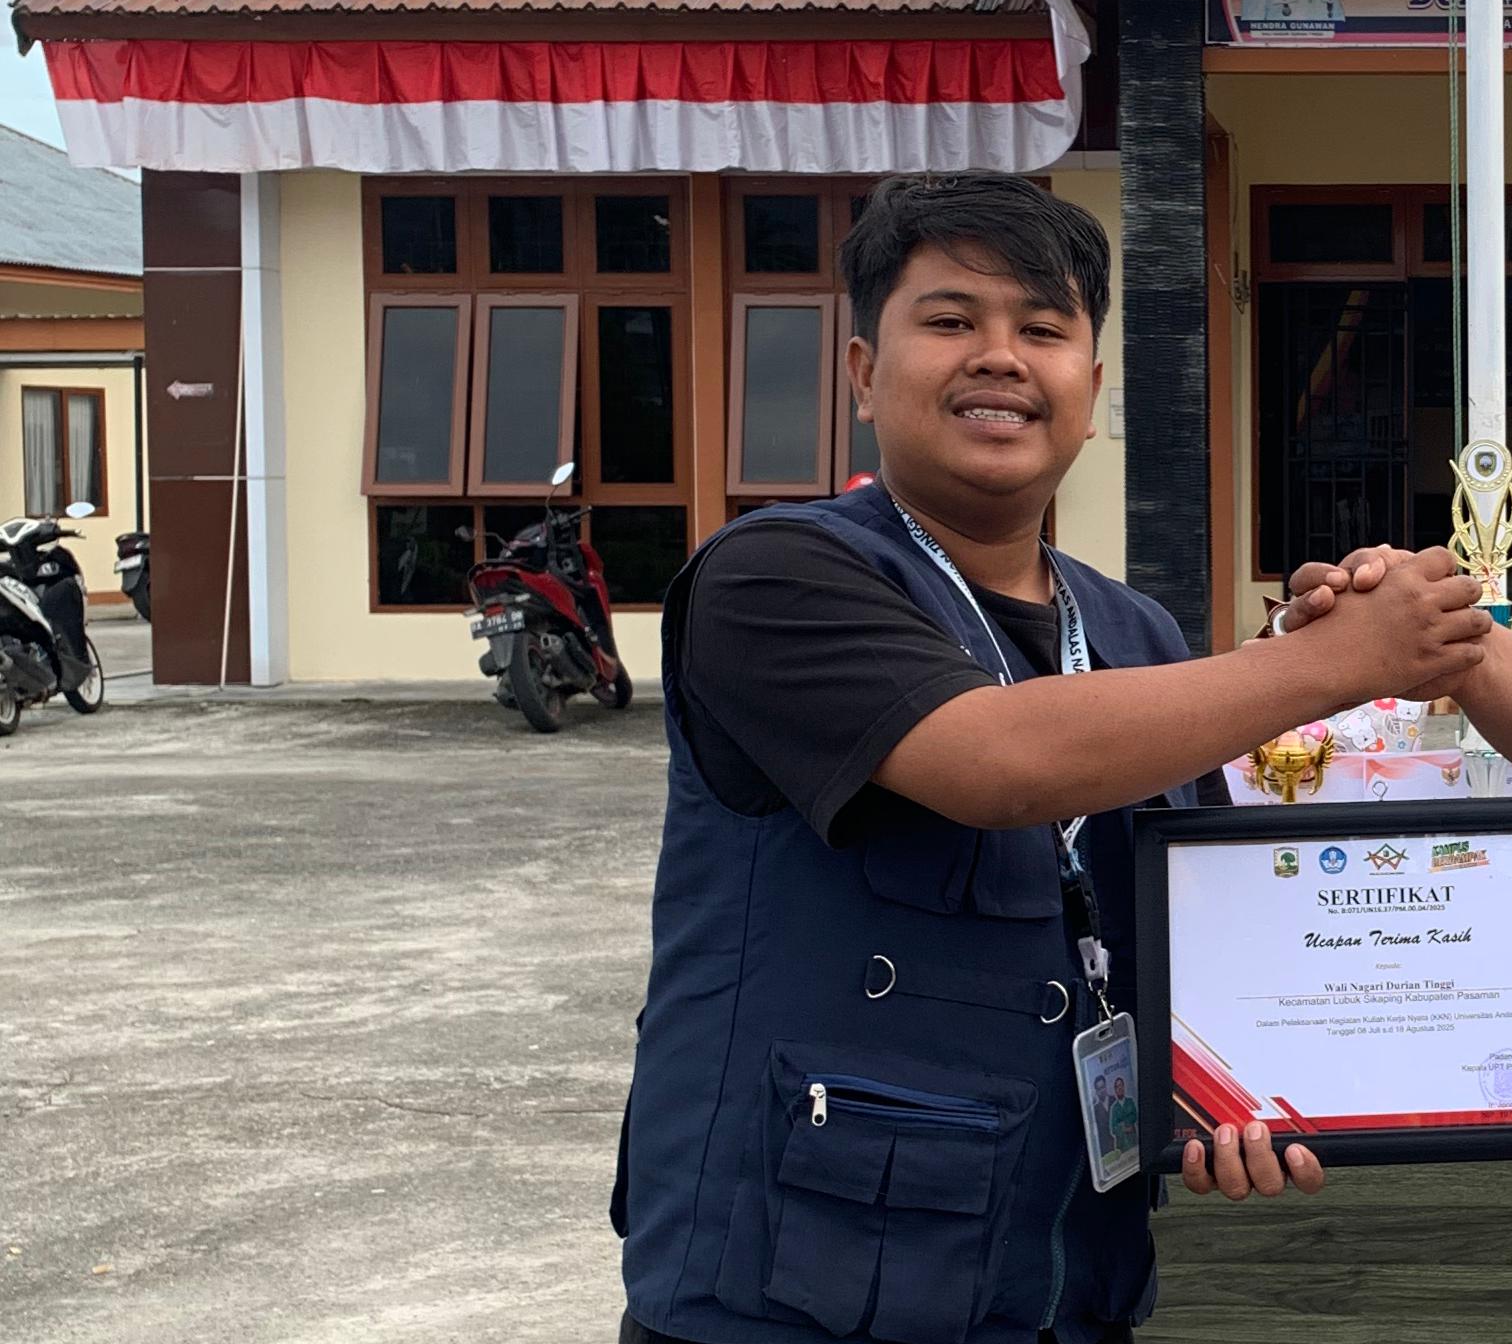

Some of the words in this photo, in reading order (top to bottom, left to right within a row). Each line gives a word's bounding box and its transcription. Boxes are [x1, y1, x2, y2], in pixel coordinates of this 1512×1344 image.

[1289, 22, 1335, 30] GUNAWAN
[906, 516, 941, 554] TINGGI
[1067, 607, 1082, 656] ANDALAS
[1317, 885, 1456, 907] SERTIFIKAT
[1304, 931, 1362, 950] Ucapan
[1368, 929, 1422, 947] Terima
[1427, 927, 1473, 945] Kasih
[1324, 983, 1347, 992] Wali
[1350, 982, 1384, 993] Nagari
[1386, 981, 1421, 990] Durian
[1424, 979, 1455, 990] Tinggi
[1279, 997, 1331, 1007] Kecamatan
[1333, 996, 1361, 1005] Lubuk
[1363, 994, 1403, 1004] Sikaping
[1405, 992, 1455, 1003] Kabupaten
[1457, 991, 1500, 1000] Pasaman
